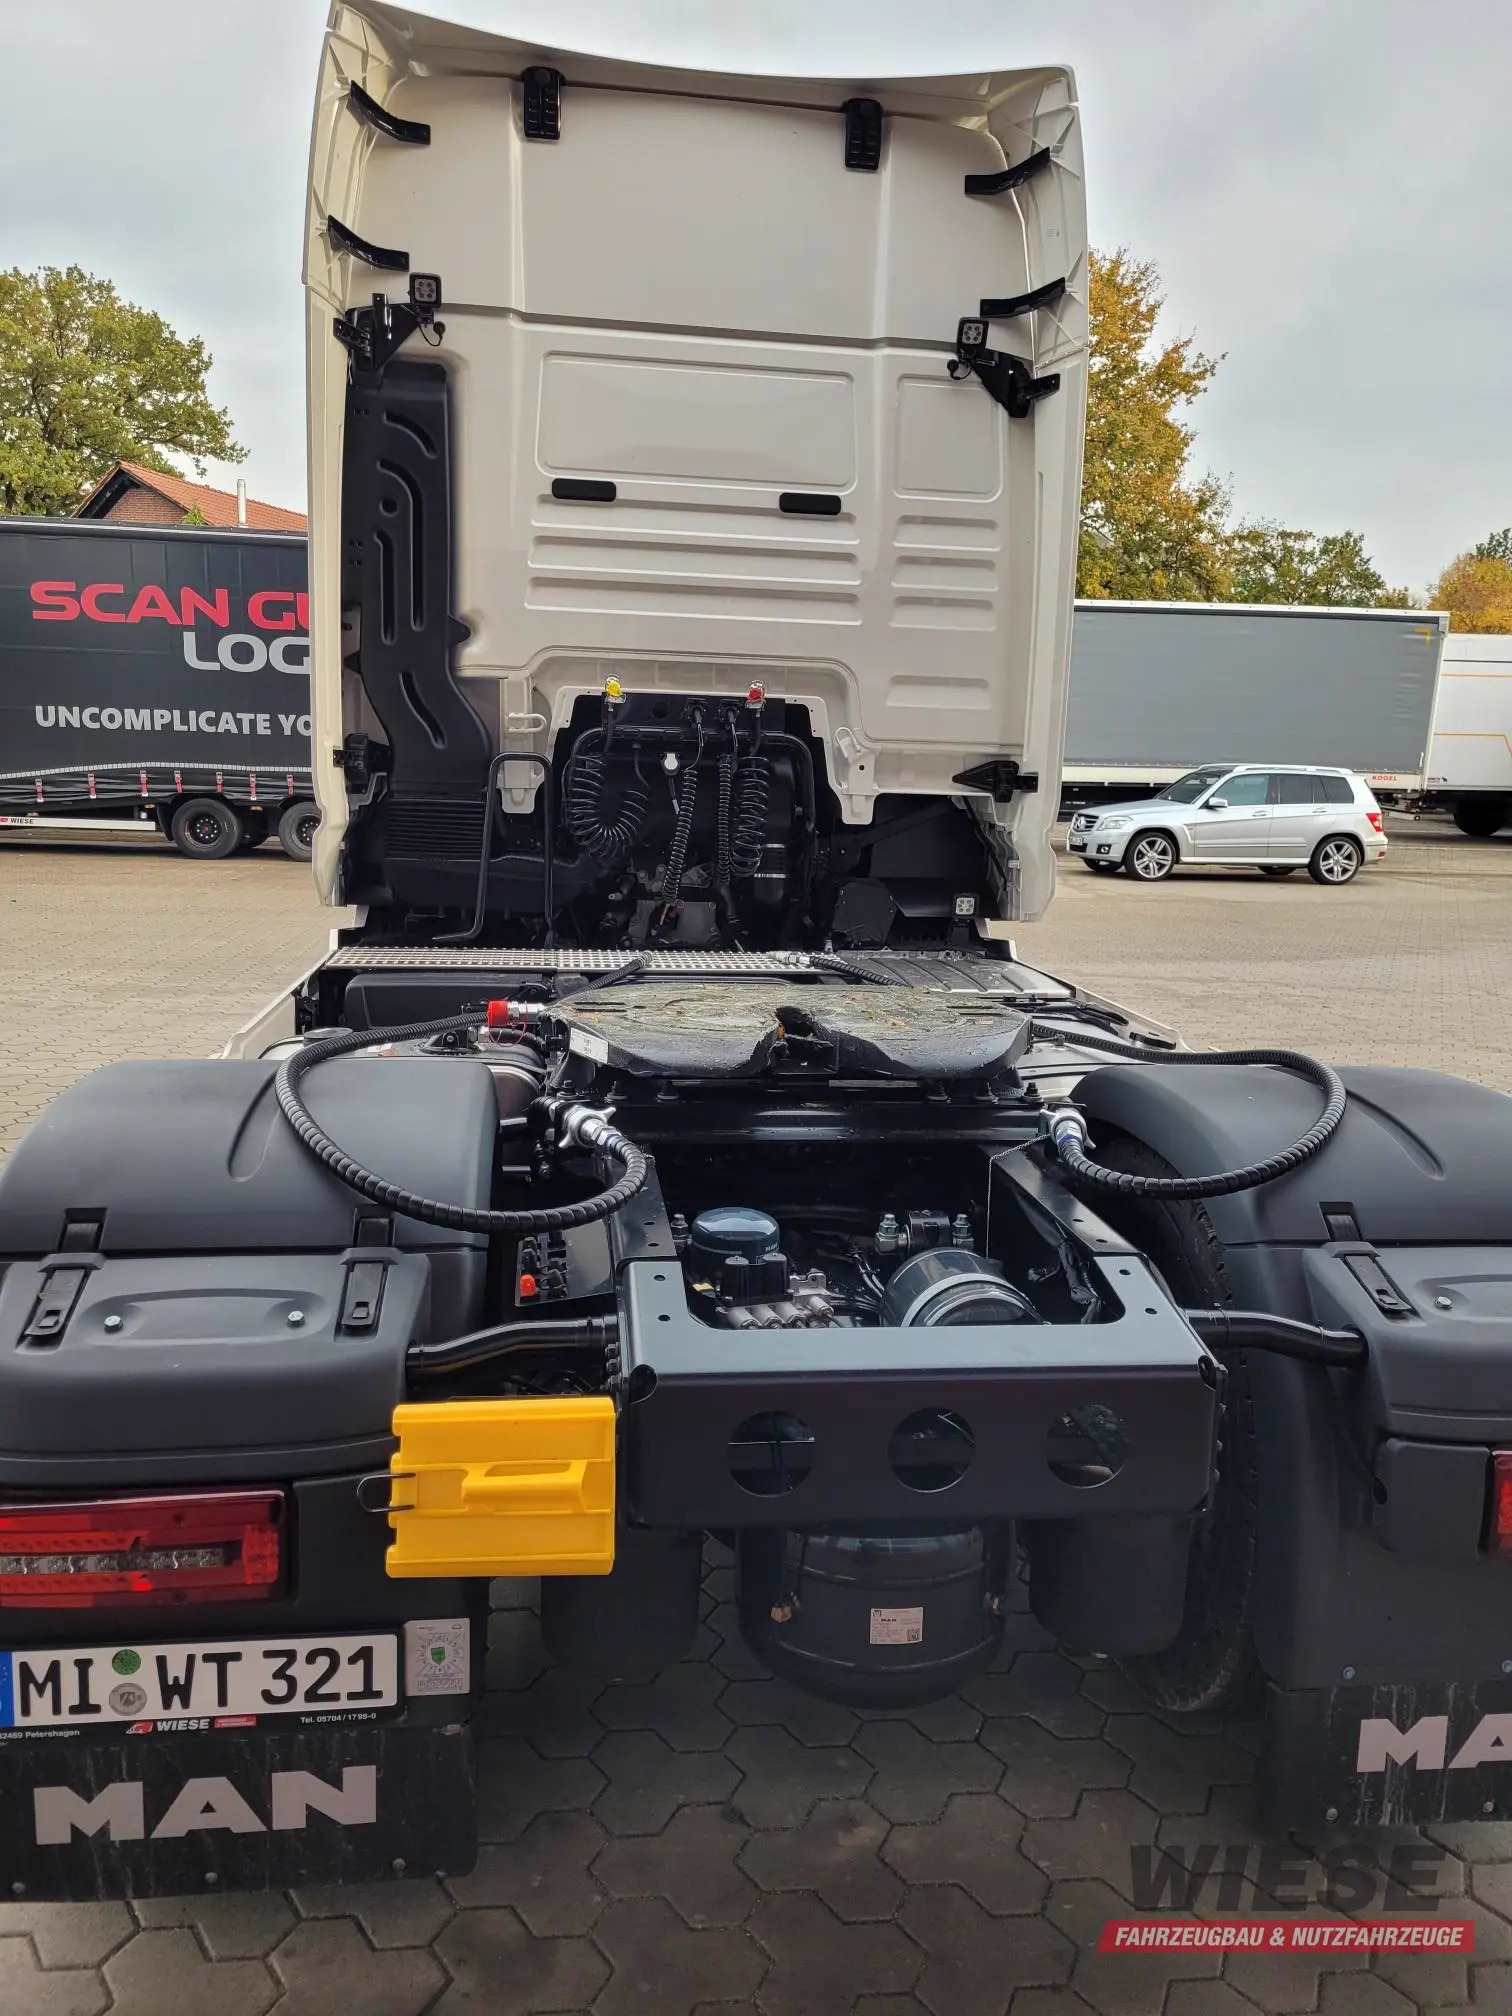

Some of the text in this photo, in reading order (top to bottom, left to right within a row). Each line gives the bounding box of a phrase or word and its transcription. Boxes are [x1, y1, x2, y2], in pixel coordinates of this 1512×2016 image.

[31, 581, 230, 627] SCAN
[35, 705, 271, 736] UNCOMPLICATE
[19, 1658, 102, 1717] MI
[156, 1652, 243, 1710] WT
[261, 1645, 384, 1705] 321
[25, 1729, 80, 1738] Petershagen
[156, 1719, 210, 1731] WIESE
[300, 1716, 315, 1724] Tel.
[34, 1765, 377, 1845] MAN
